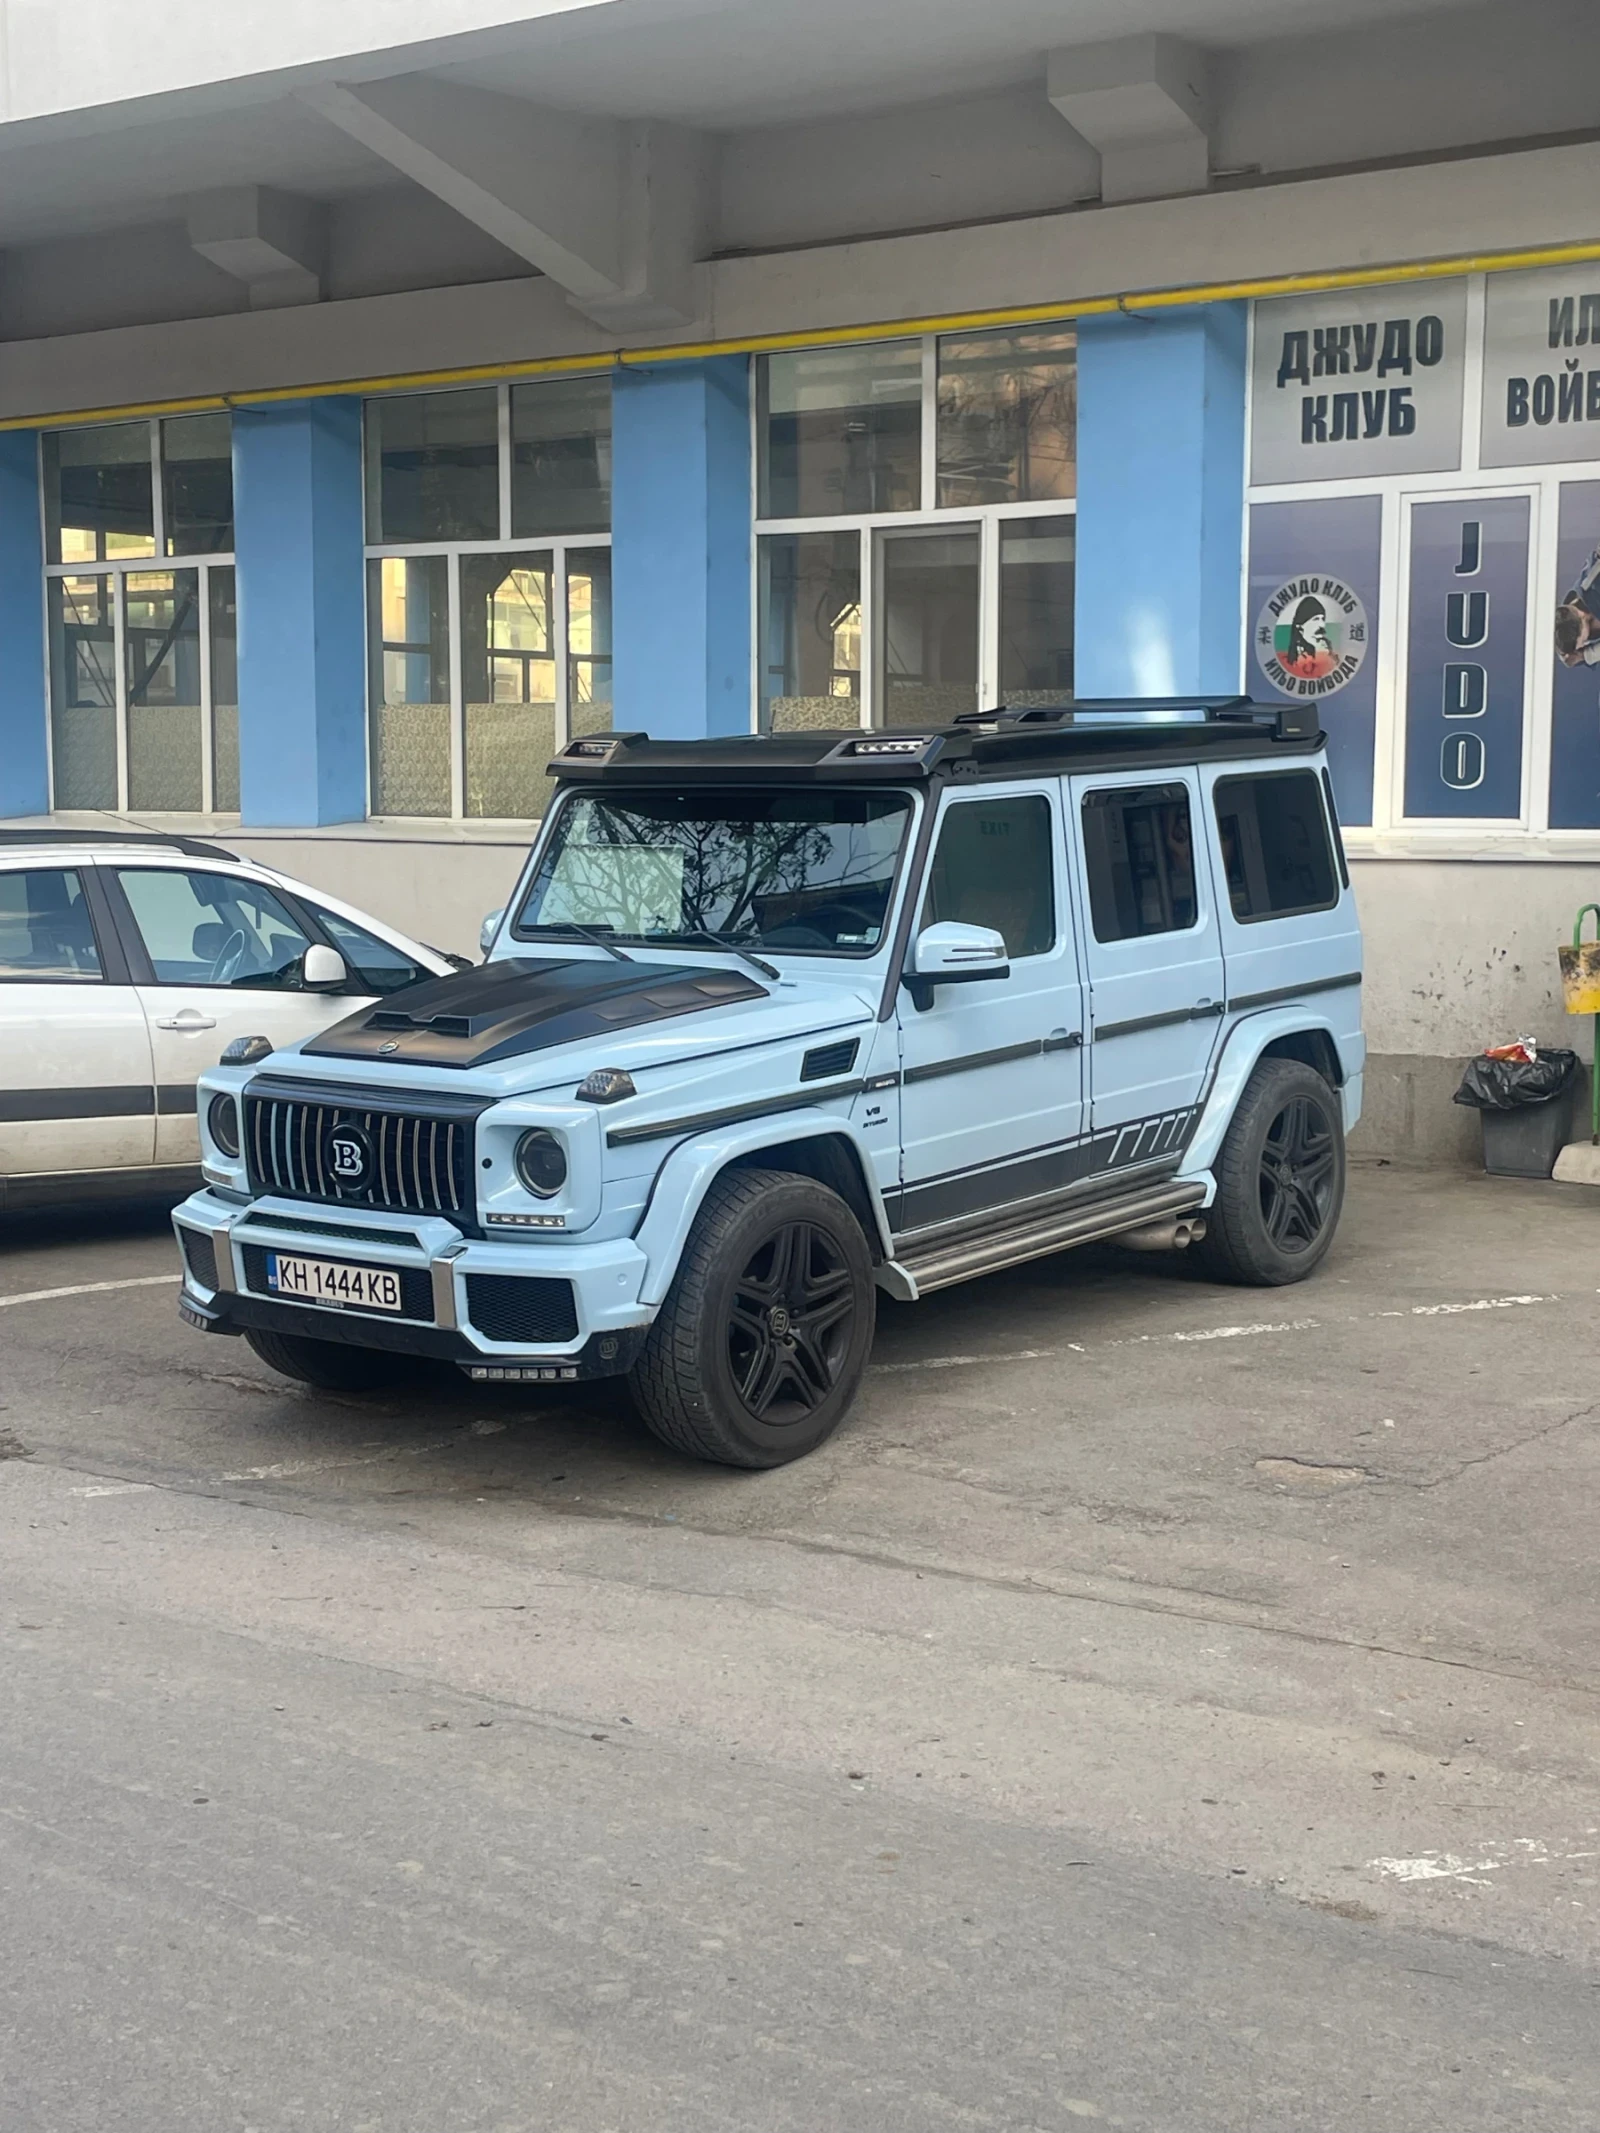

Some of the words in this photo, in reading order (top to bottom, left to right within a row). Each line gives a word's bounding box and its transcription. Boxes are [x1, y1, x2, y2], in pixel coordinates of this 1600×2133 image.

[1277, 315, 1443, 388] ДЖУДО
[1301, 387, 1416, 444] КЛУБ
[1268, 578, 1320, 618] ДЖУДО
[1322, 580, 1358, 614] КЛУБ
[1440, 521, 1489, 789] JUDO
[333, 1140, 363, 1176] B
